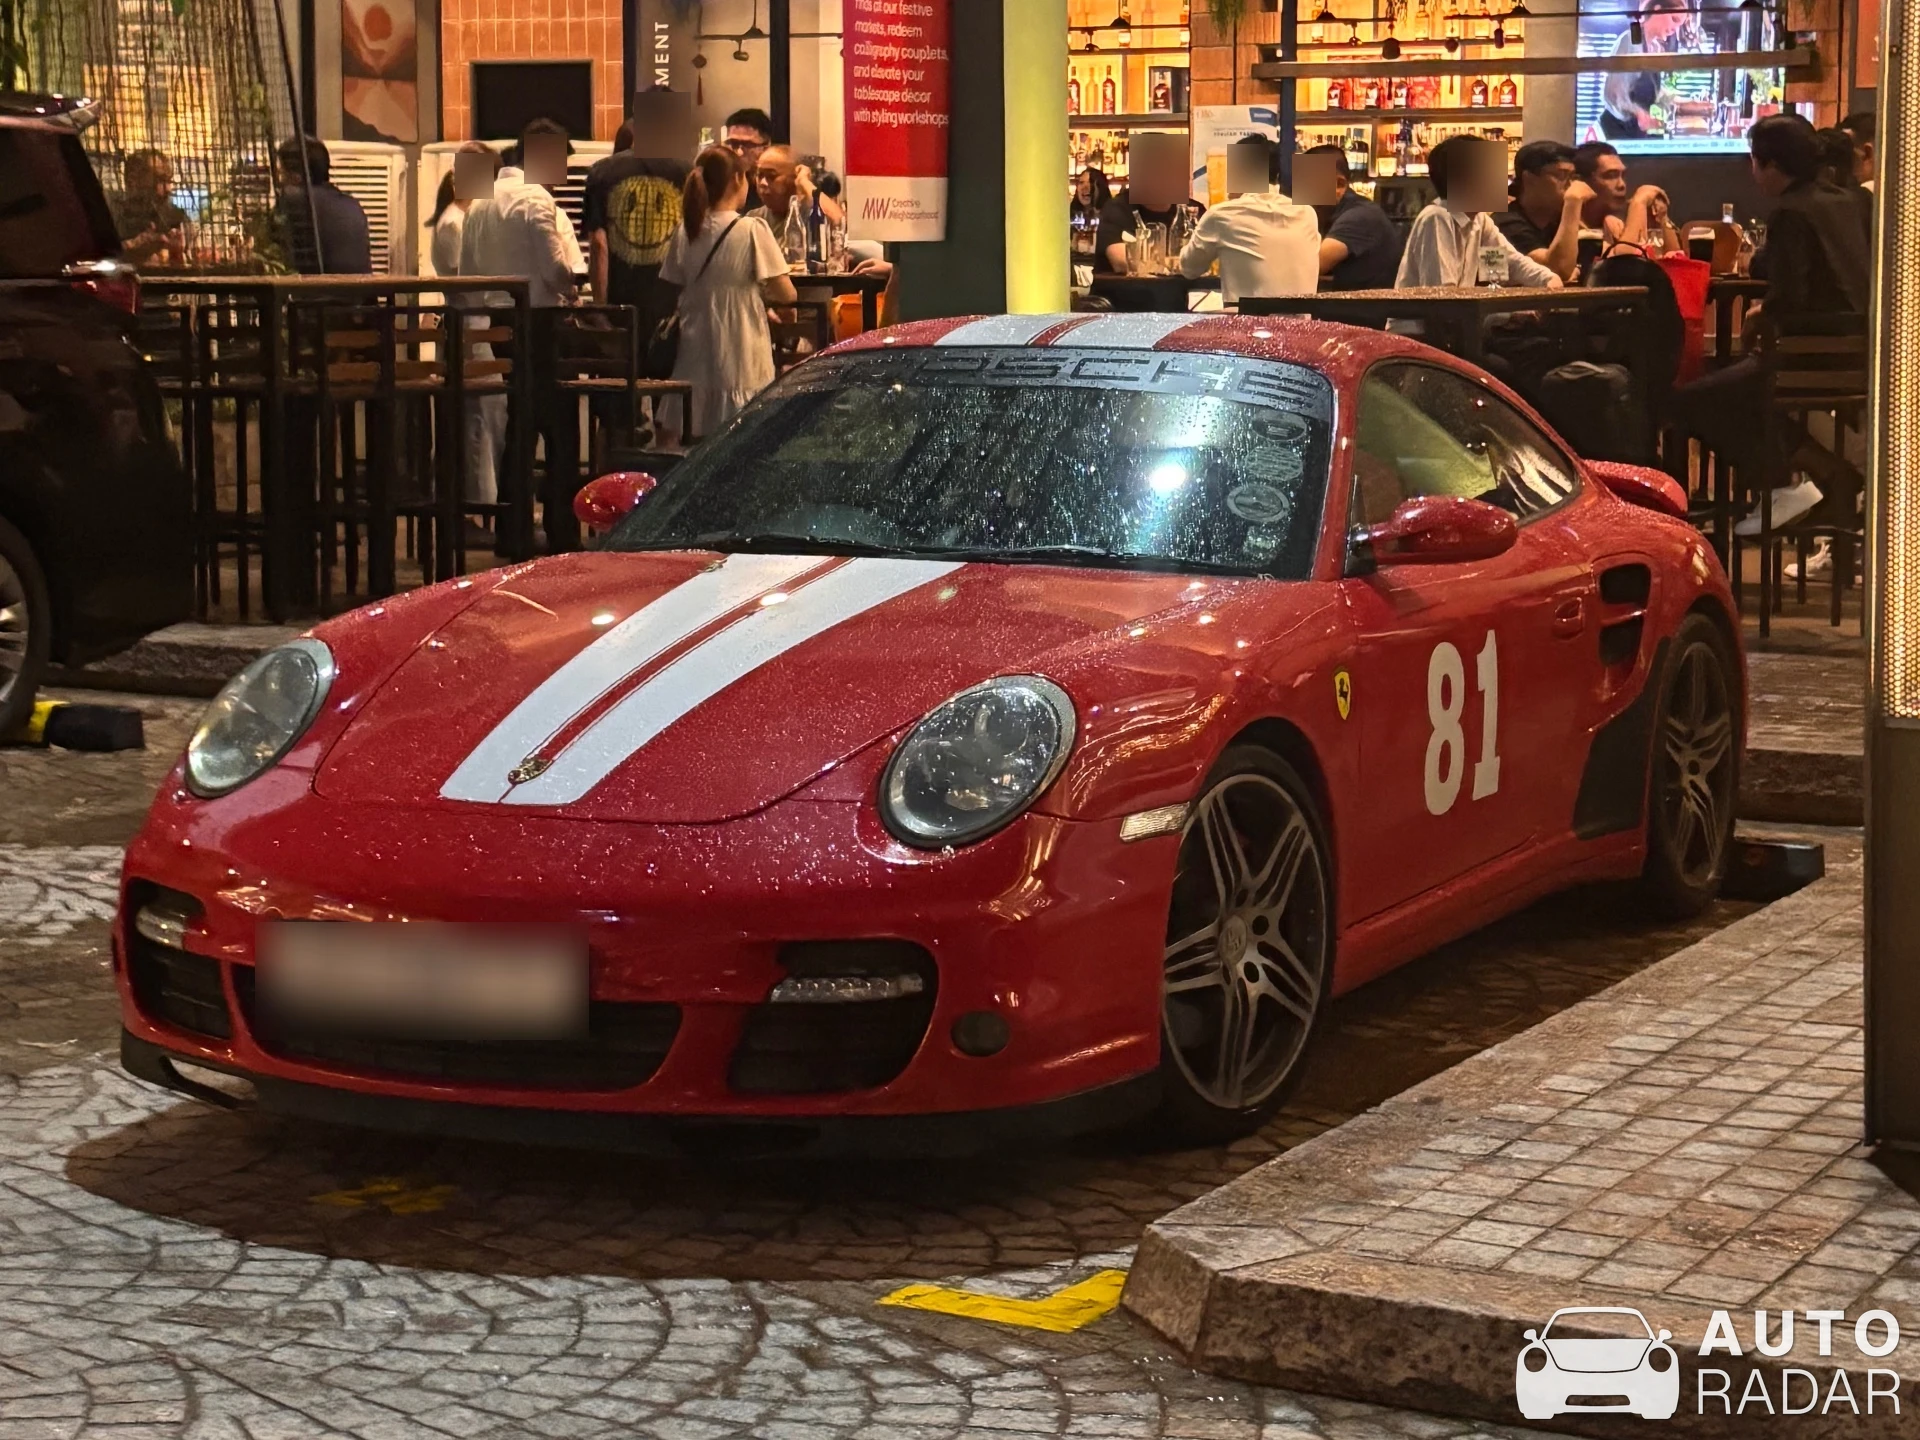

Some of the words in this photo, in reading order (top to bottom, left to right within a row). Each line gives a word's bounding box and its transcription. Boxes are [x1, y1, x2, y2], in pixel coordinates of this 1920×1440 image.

[883, 3, 898, 15] our
[899, 0, 933, 17] festive
[887, 22, 923, 38] redeem
[854, 41, 900, 61] calligraphy
[901, 45, 949, 63] couplets,
[854, 64, 870, 78] and
[871, 64, 901, 80] elevate
[902, 69, 925, 85] your
[854, 85, 900, 105] tablescape
[854, 108, 871, 122] with
[872, 108, 898, 128] styling
[897, 110, 949, 128] workshops
[1424, 629, 1500, 815] 81
